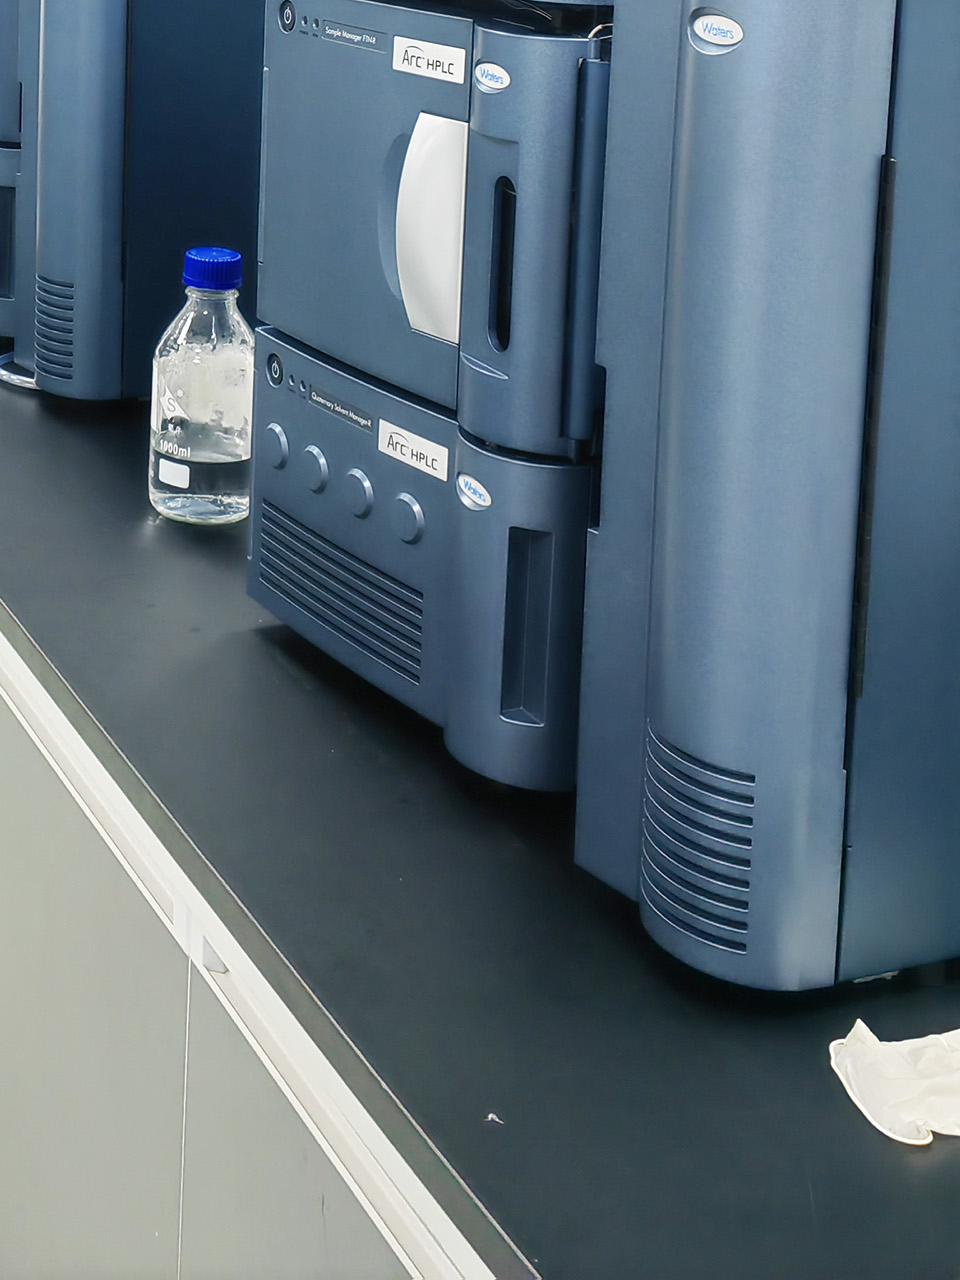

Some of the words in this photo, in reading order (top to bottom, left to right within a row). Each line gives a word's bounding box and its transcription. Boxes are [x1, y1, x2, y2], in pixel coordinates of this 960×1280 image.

[325, 26, 342, 38] Sample
[341, 30, 362, 43] Manager
[701, 20, 735, 40] Waters
[426, 58, 455, 76] HPLC
[480, 66, 504, 85] Waters
[167, 397, 176, 412] S
[159, 438, 191, 459] 1000ml
[410, 448, 439, 472] HPLC
